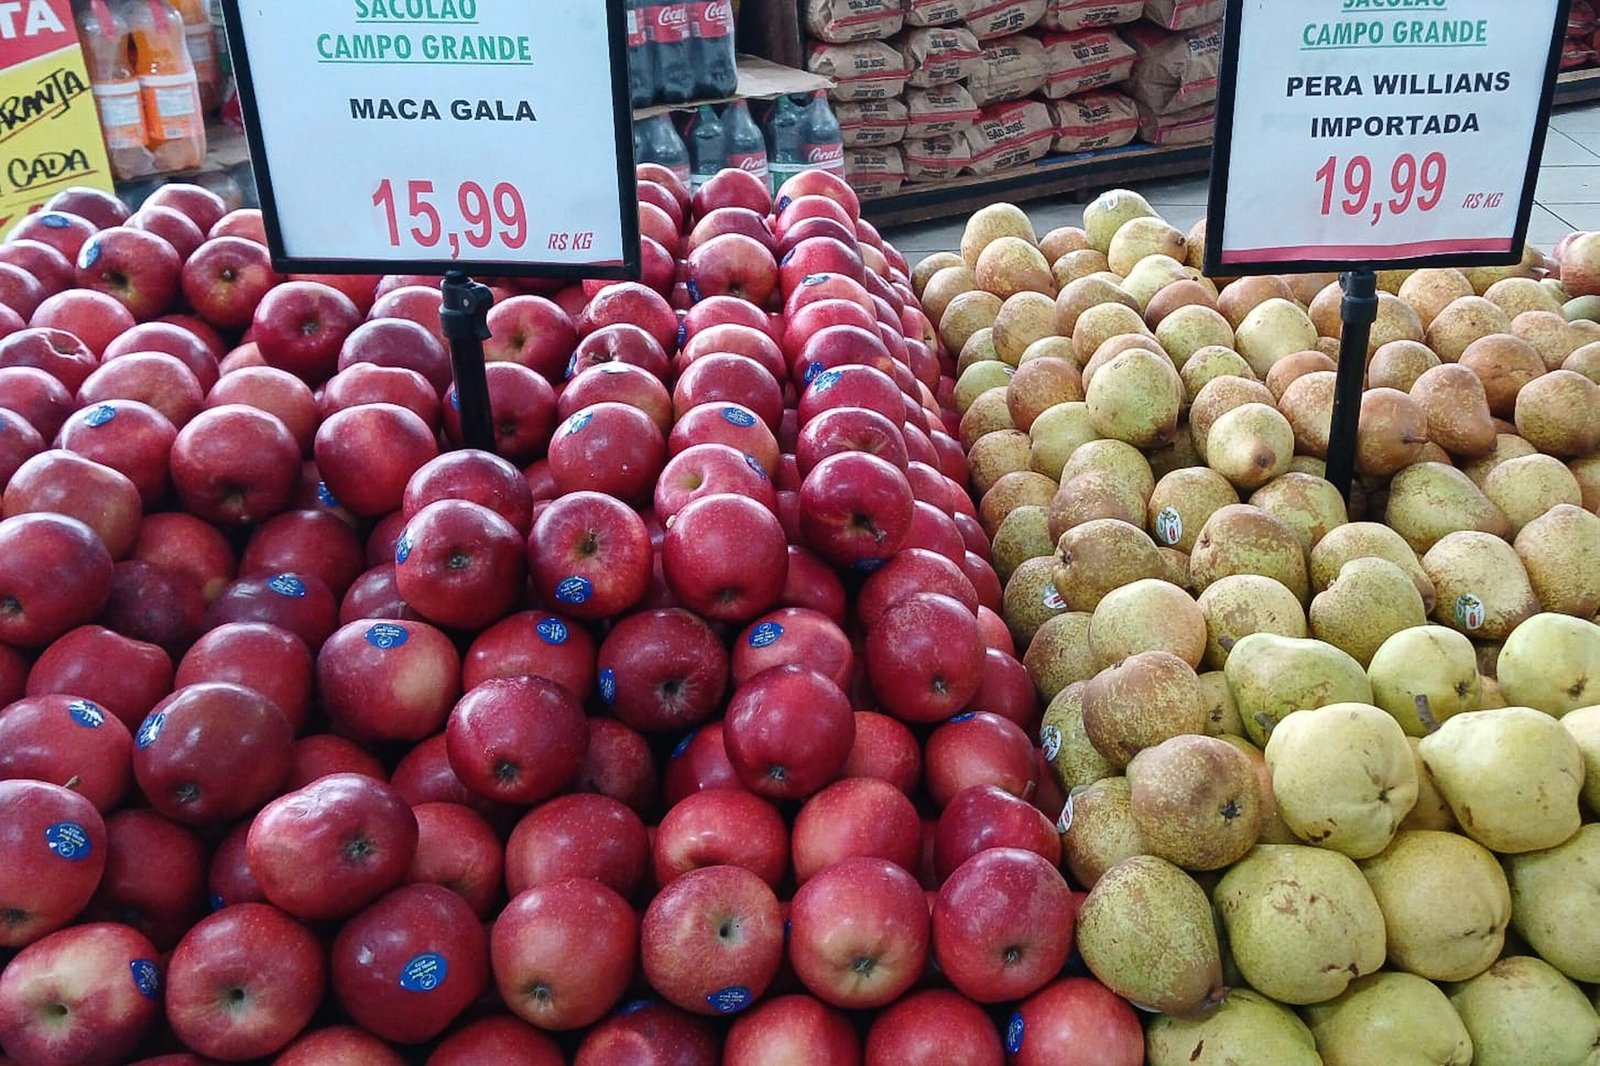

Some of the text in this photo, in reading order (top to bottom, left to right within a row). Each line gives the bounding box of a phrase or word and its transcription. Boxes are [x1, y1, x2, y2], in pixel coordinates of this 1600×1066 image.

[1303, 19, 1487, 46] CAMPO GRANDE
[317, 34, 531, 62] CAMPO GRANDE
[1286, 71, 1511, 97] PERA WILLIANS
[350, 98, 536, 121] MACA GALA
[1311, 113, 1479, 138] IMPORTADA
[8, 150, 90, 187] CADA
[1315, 152, 1447, 226] 19,99
[1483, 193, 1504, 208] KG
[372, 179, 528, 259] 15,99
[547, 232, 593, 250] R$ KG
